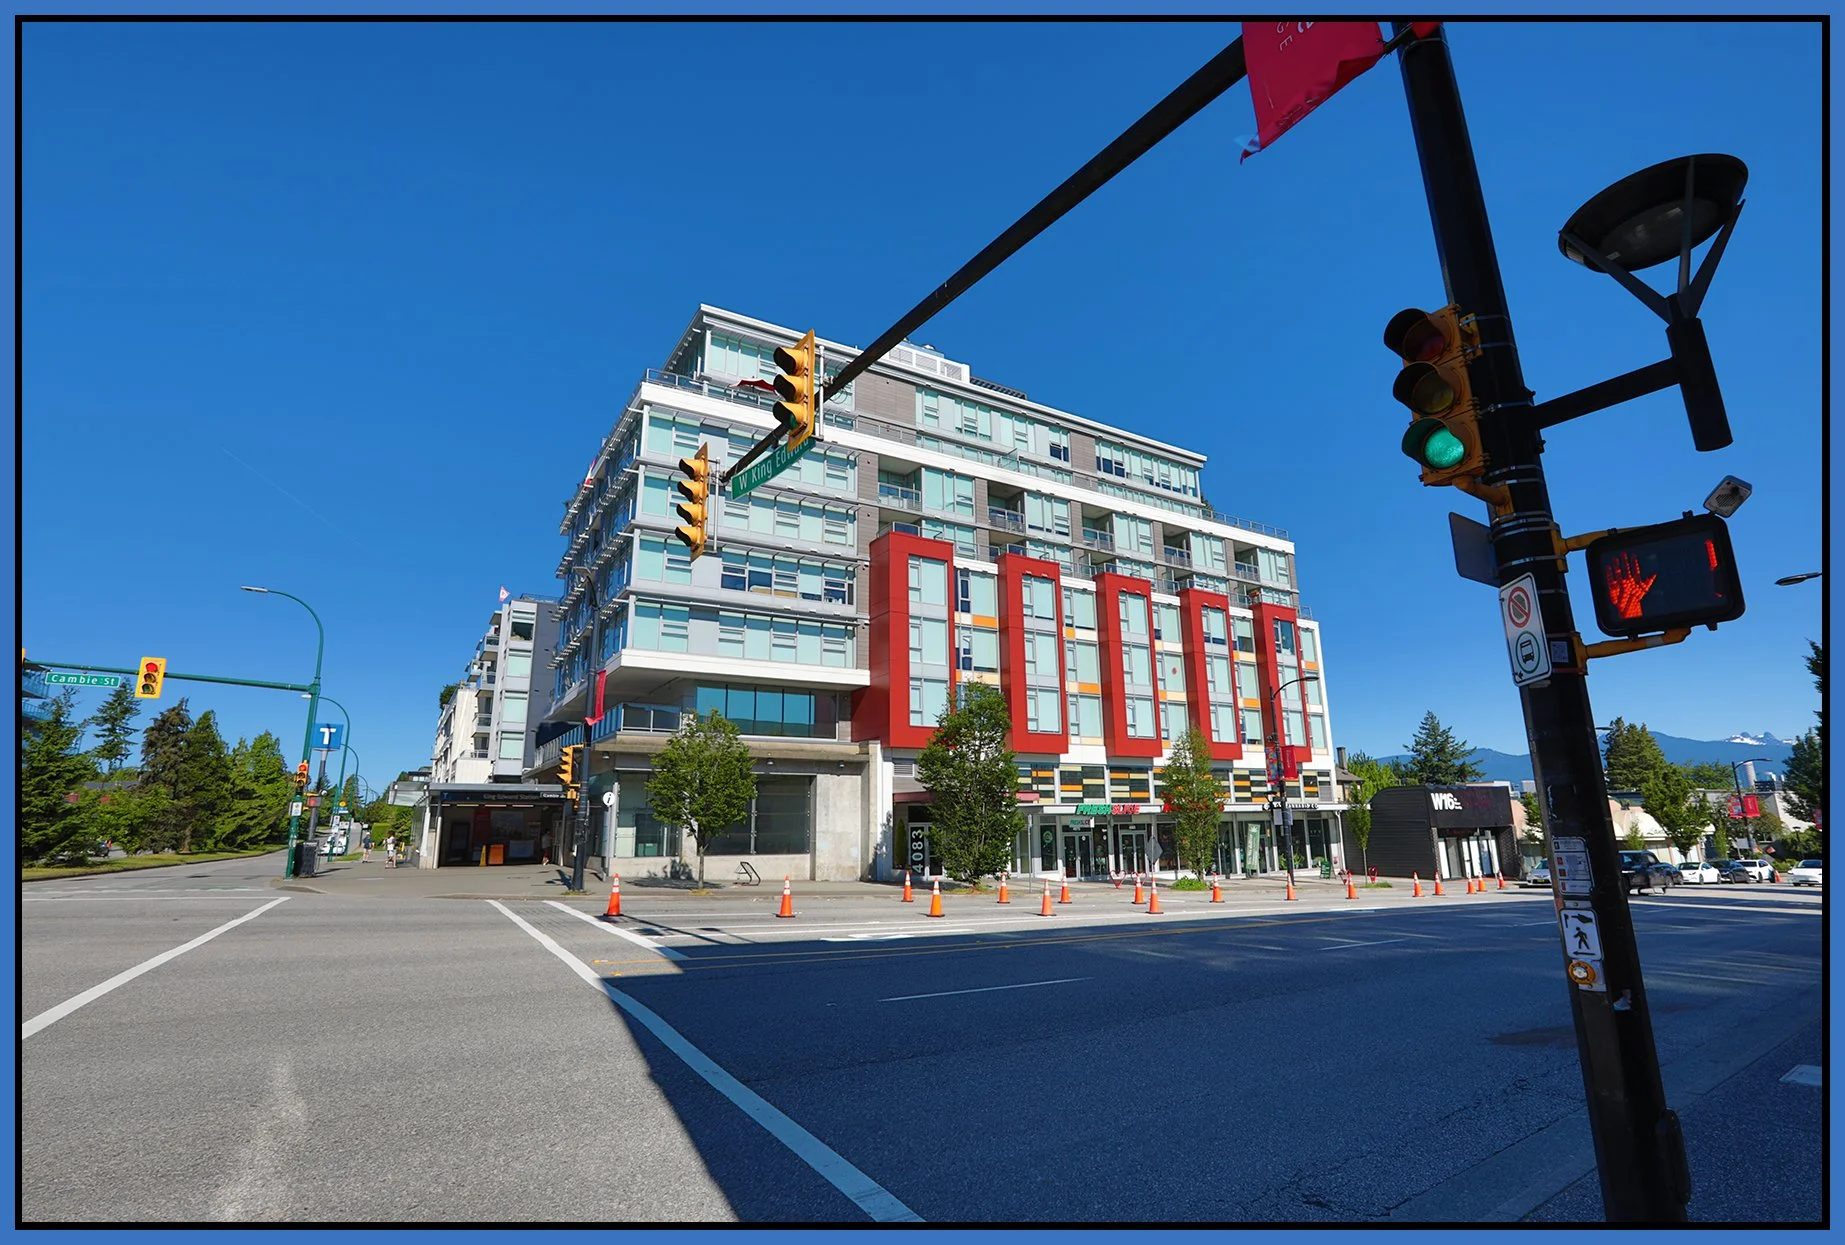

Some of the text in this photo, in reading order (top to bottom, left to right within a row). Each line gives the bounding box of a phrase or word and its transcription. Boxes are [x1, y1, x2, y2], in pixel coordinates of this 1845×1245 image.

[739, 473, 748, 490] W
[752, 459, 773, 483] King
[51, 674, 115, 686] Cambie St
[320, 728, 336, 745] T
[1430, 793, 1456, 811] W16
[911, 829, 924, 873] 4083
